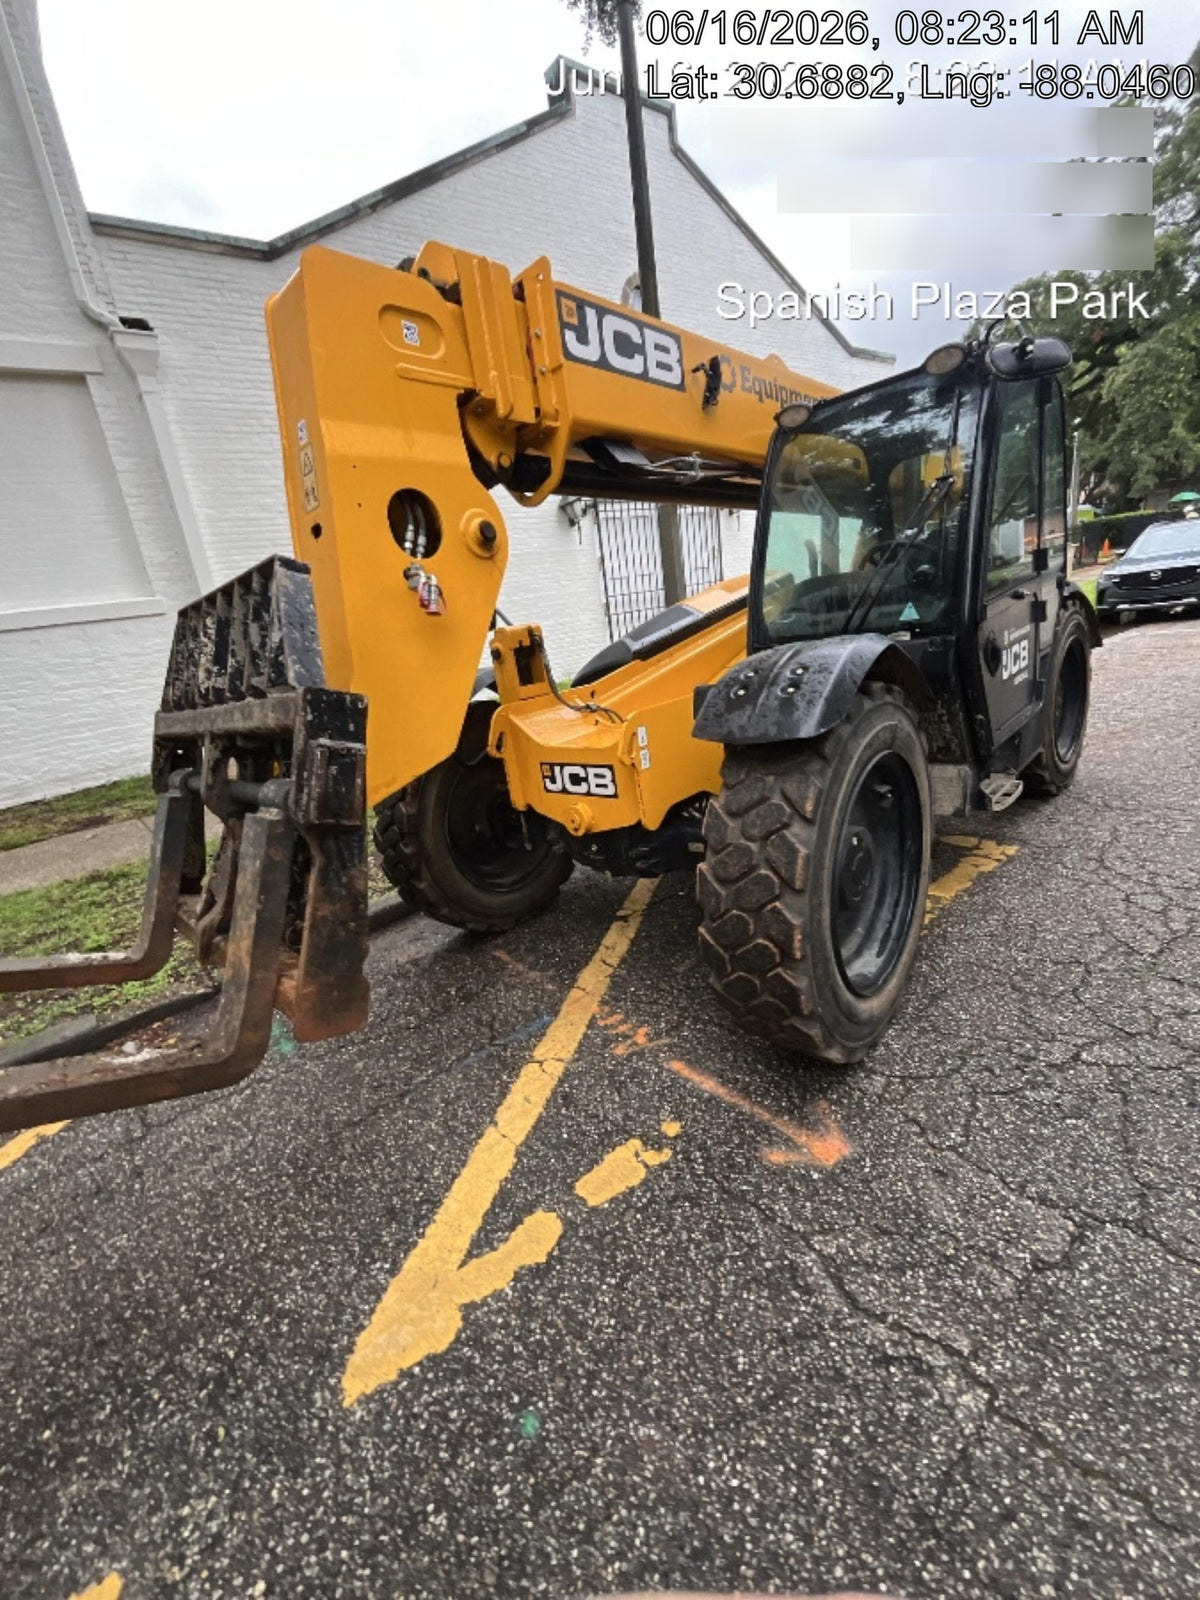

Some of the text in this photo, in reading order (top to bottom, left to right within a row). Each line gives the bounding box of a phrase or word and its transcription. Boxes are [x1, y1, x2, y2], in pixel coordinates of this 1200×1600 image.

[563, 305, 683, 385] JCB
[1001, 639, 1029, 681] JCB
[543, 765, 616, 796] JCB
